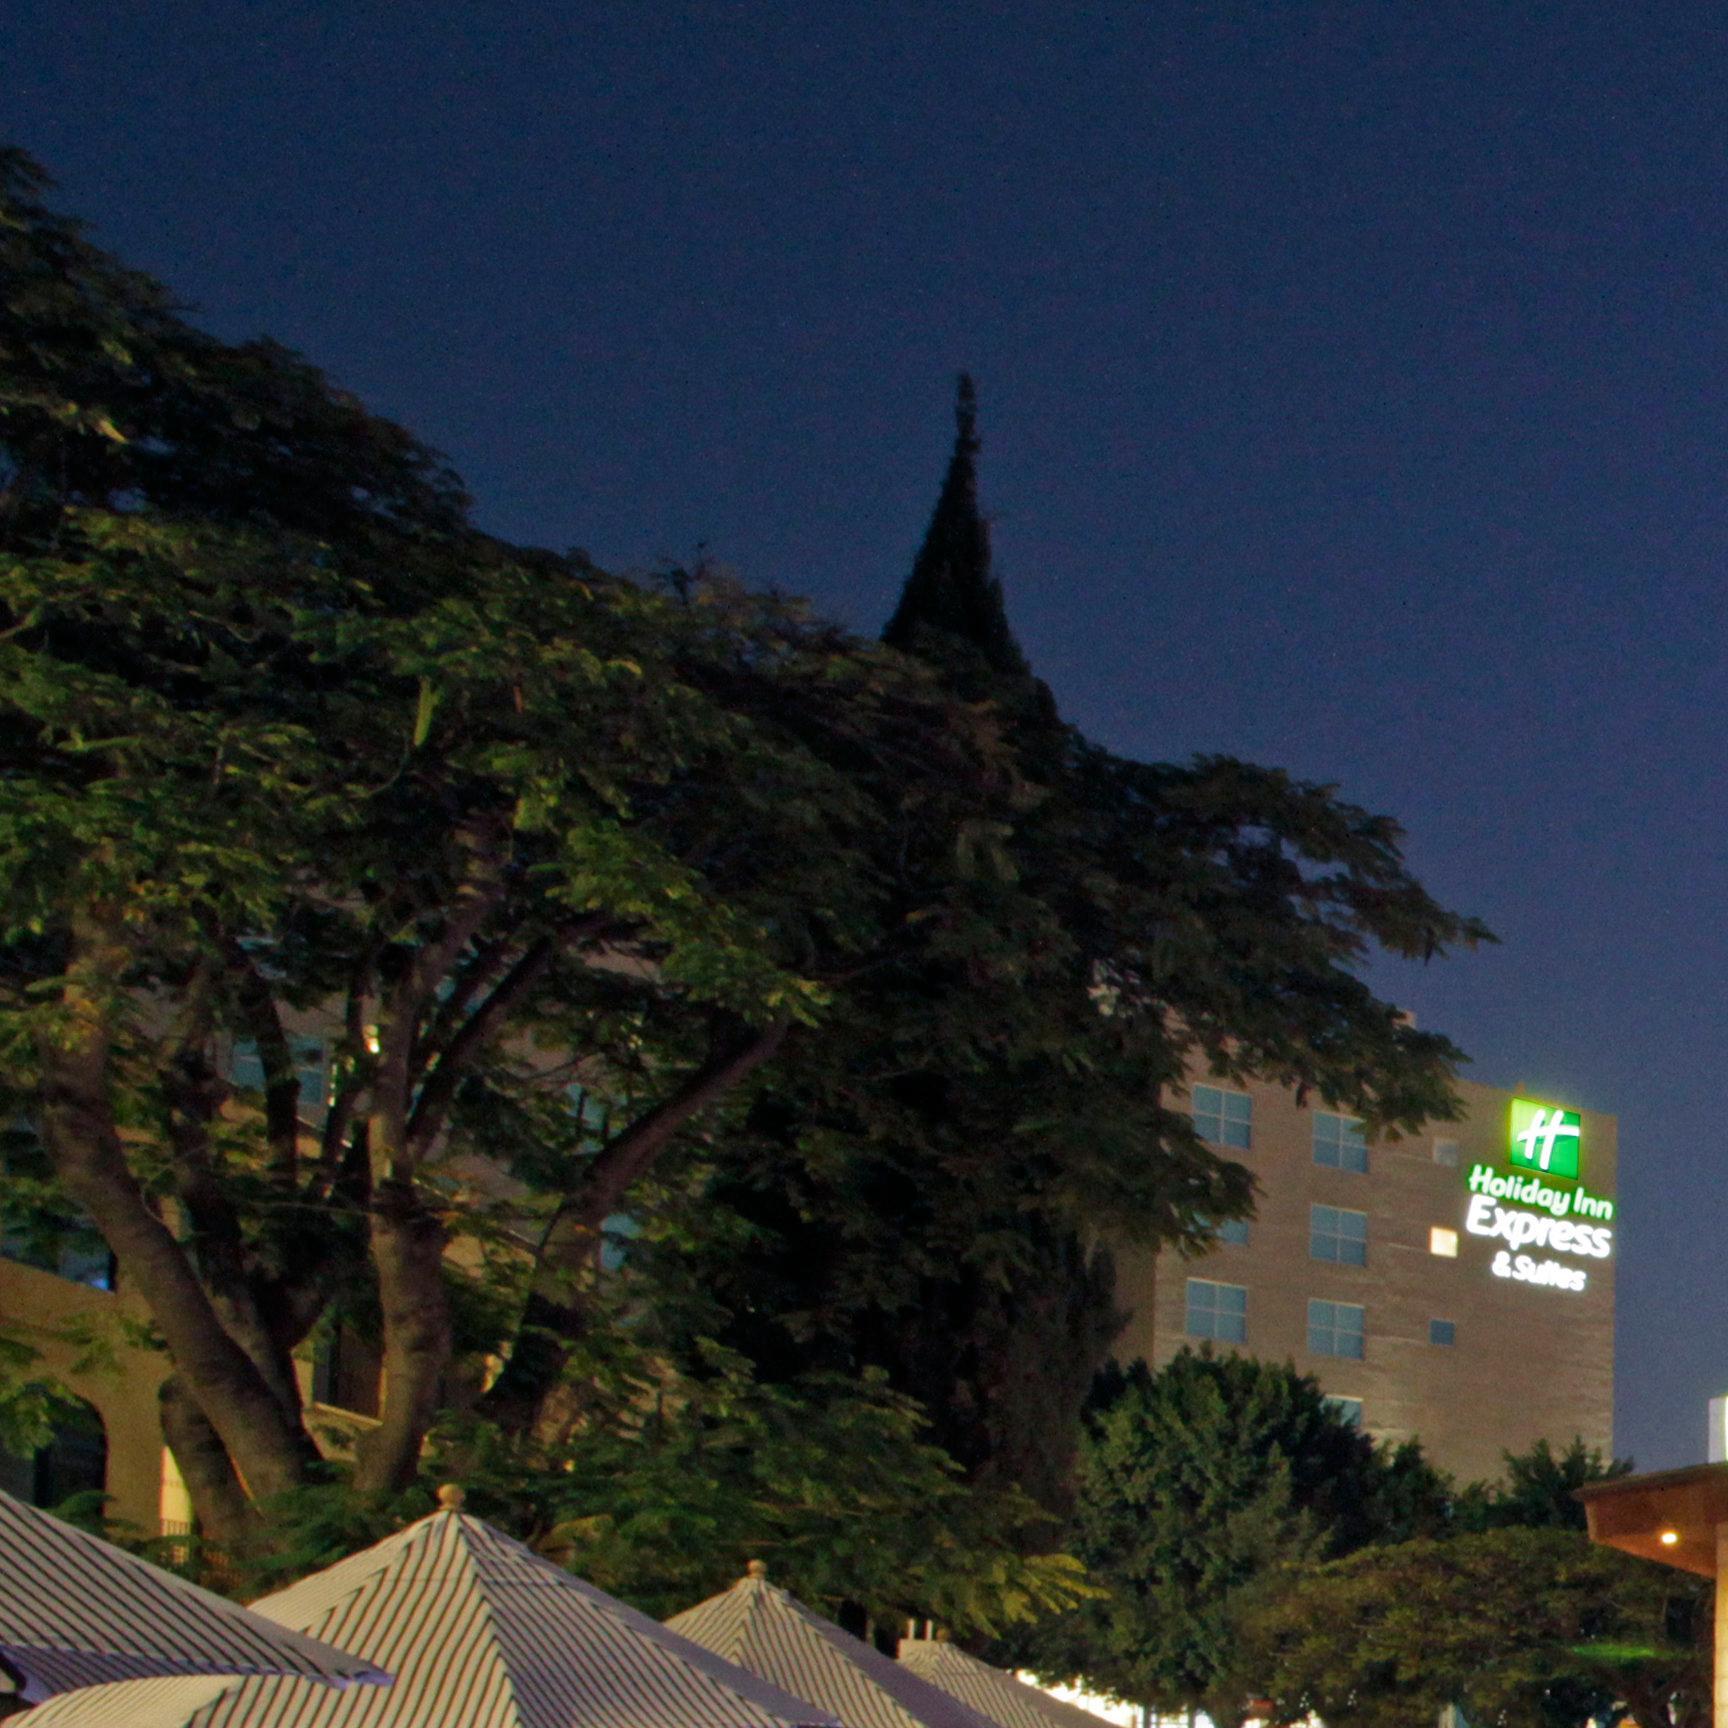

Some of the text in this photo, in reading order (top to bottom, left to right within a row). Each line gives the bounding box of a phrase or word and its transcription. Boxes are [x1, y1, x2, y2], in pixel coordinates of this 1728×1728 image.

[1517, 1109, 1580, 1170] H
[1469, 1164, 1613, 1220] Holiday Inn
[1466, 1194, 1613, 1258] Express
[1491, 1250, 1586, 1291] & Suites
